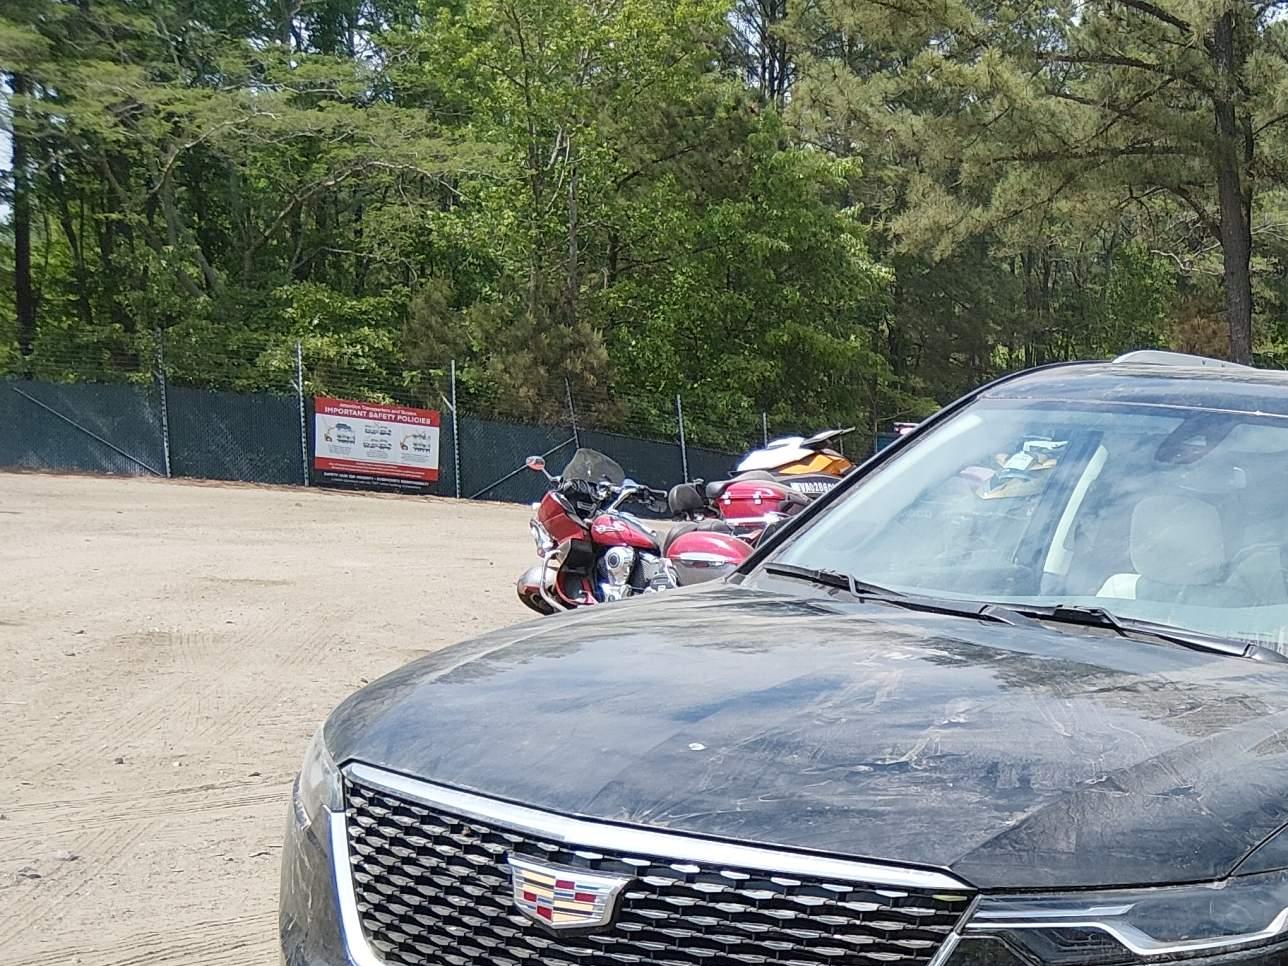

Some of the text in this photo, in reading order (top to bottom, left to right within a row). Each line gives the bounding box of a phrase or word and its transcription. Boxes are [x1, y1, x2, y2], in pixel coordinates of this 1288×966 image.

[325, 406, 431, 425] IMPORTANT SAFETY POLICIES
